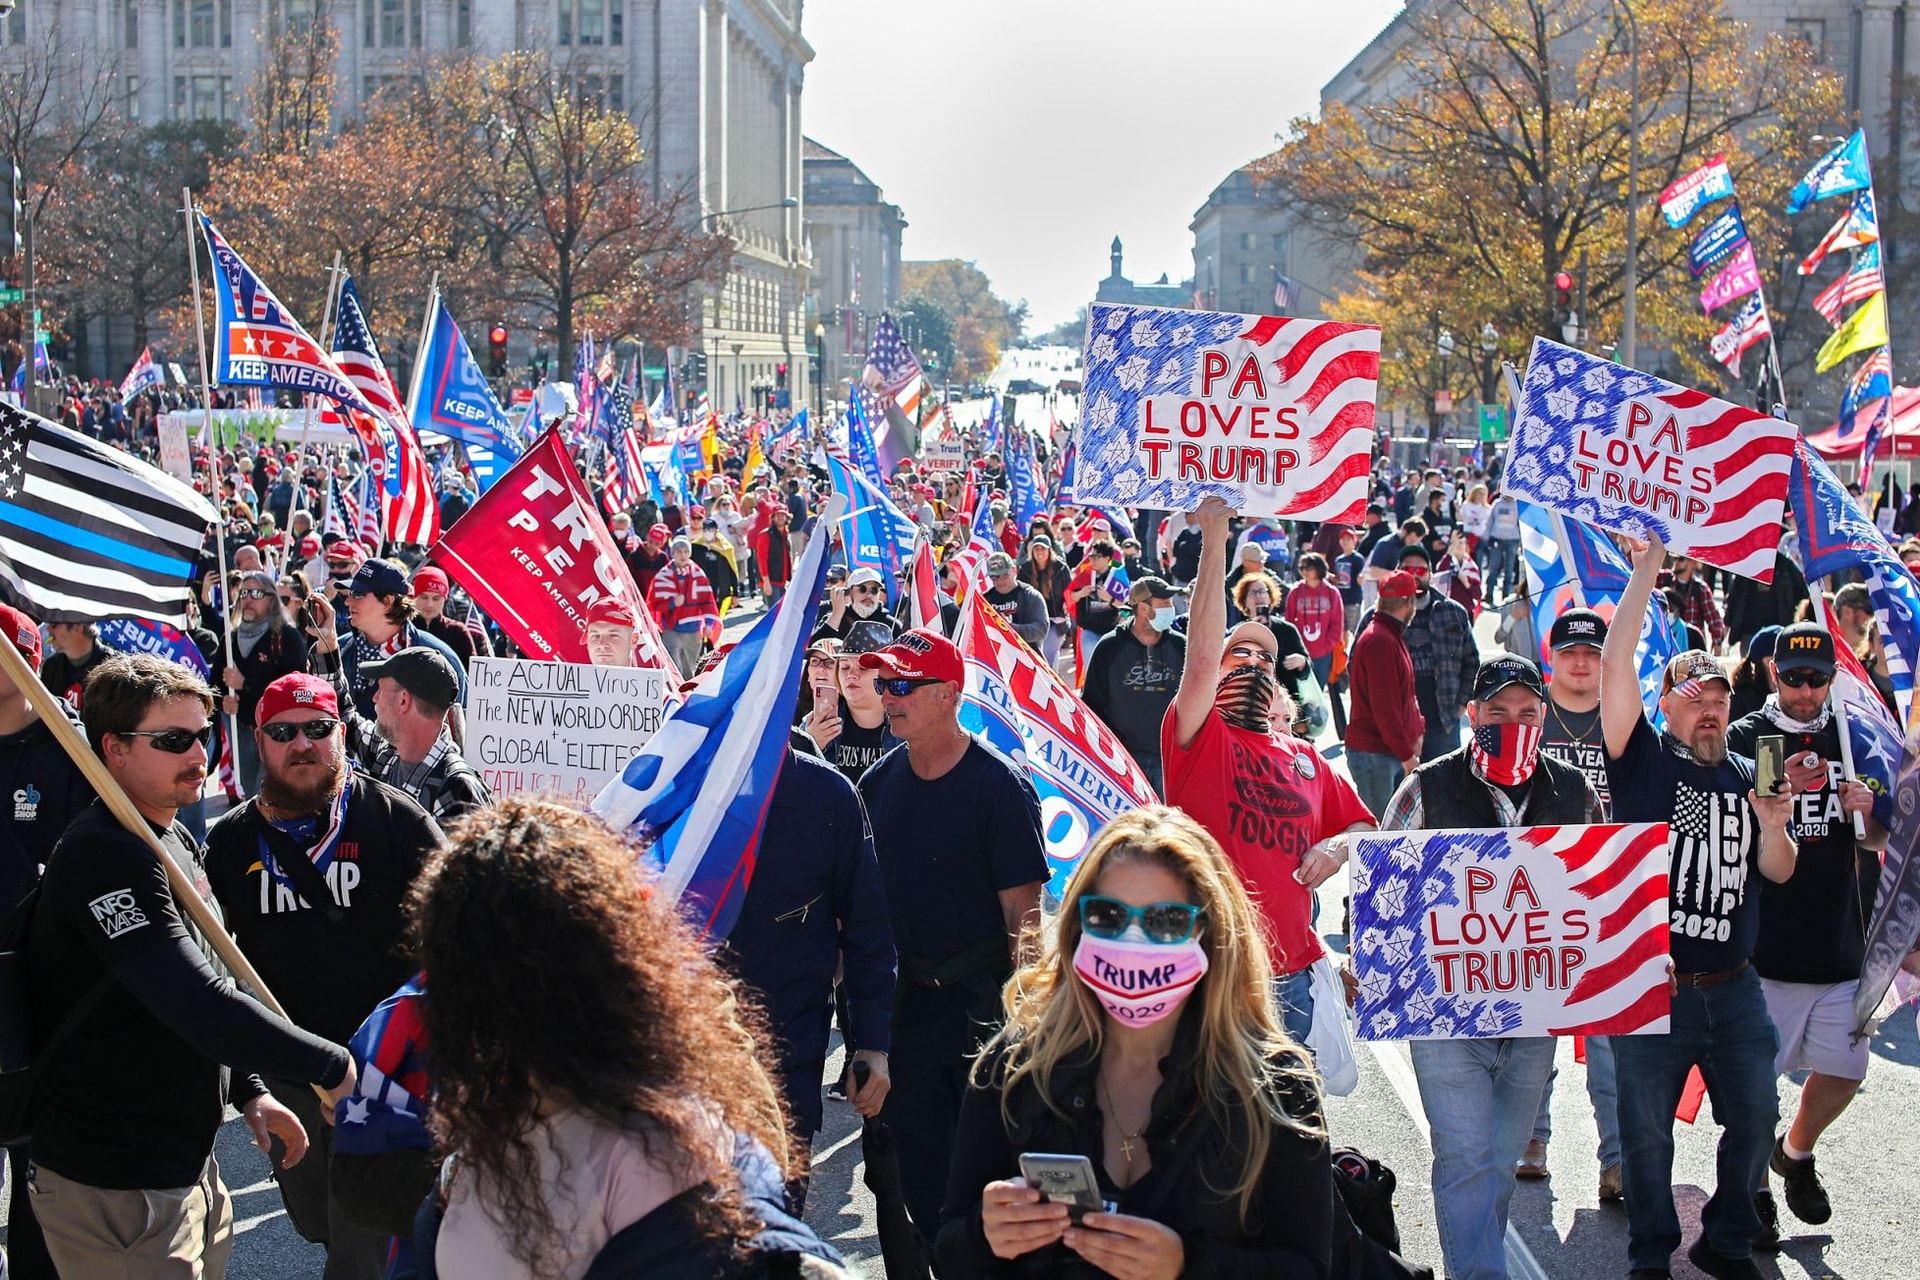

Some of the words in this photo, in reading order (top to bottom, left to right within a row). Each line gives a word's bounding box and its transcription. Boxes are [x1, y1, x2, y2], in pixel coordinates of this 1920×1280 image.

[229, 361, 268, 380] KEEP
[1202, 350, 1267, 400] PA
[444, 399, 485, 420] KEEP
[1145, 400, 1300, 439] LOVES
[1626, 401, 1682, 454] PA
[940, 444, 961, 453] Trust
[1140, 439, 1300, 486] TRUMP
[1579, 430, 1713, 494] LOVES
[927, 458, 961, 471] VERIFY
[1573, 460, 1710, 524] TRUMP
[509, 547, 543, 578] KEEP
[1568, 621, 1595, 629] TRUMP
[528, 629, 553, 654] 2020
[1790, 636, 1822, 650] M17
[472, 661, 502, 688] The
[508, 661, 590, 693] ACTUAL
[595, 668, 638, 698] Virus
[645, 675, 659, 700] is
[1491, 660, 1525, 670] Trump
[477, 699, 502, 721] The
[507, 698, 546, 725] NEW
[551, 701, 606, 729] WORLD
[609, 703, 661, 733] ORDER
[980, 675, 1033, 738] KEP
[479, 735, 559, 765] GLOBAL
[15, 802, 38, 811] SURF
[15, 810, 37, 819] SHOP
[1796, 823, 1829, 837] 2020
[1720, 792, 1741, 916] TRUMP
[1465, 865, 1541, 912] PA
[90, 893, 135, 922] INFO
[100, 907, 147, 936] WARS
[1430, 910, 1590, 946] LOVES
[1669, 910, 1731, 943] 2020
[1093, 954, 1176, 990] TRUMP
[1431, 946, 1586, 995] TRUMP
[1107, 1001, 1167, 1020] 2020
